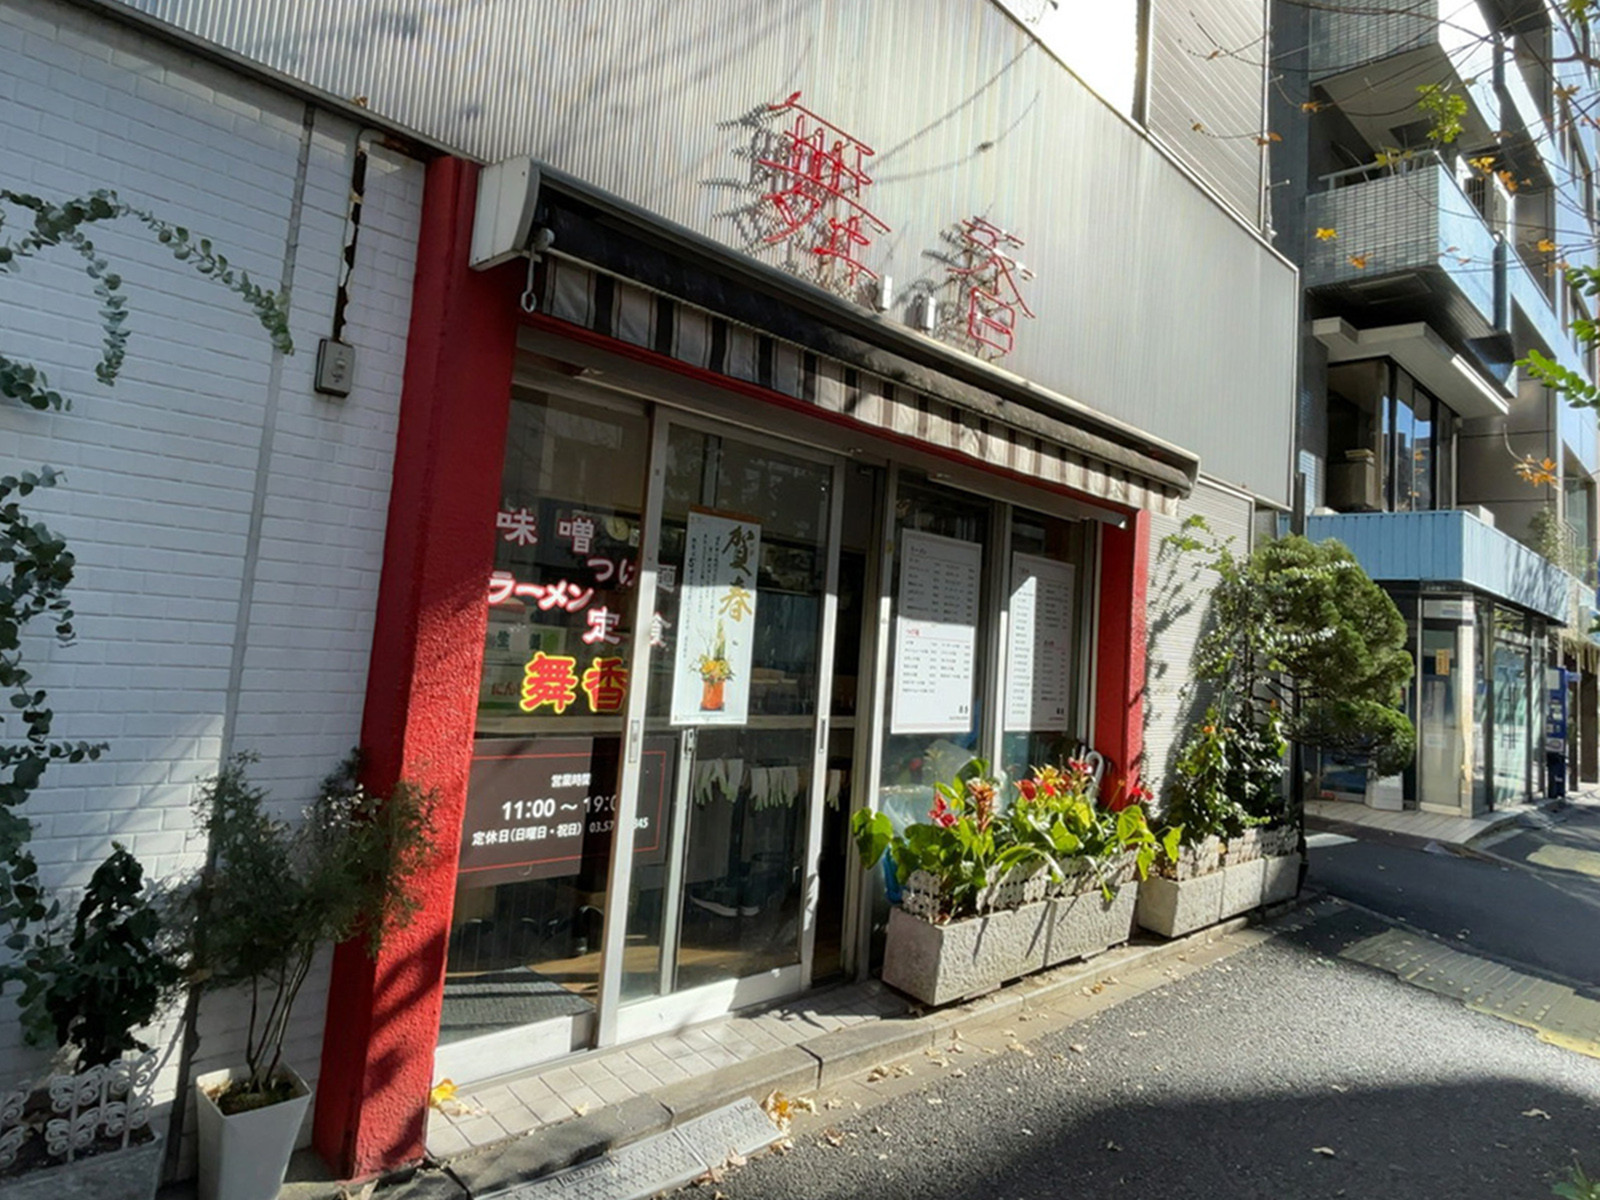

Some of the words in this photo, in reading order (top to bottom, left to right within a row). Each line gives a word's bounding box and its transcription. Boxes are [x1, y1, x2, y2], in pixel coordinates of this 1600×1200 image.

[496, 508, 594, 553] 味噌
[488, 571, 594, 611] ラーメン
[519, 650, 628, 714] 舞香
[551, 773, 591, 788] 営業時間
[502, 798, 555, 820] 11:00
[583, 795, 616, 814] 19:0
